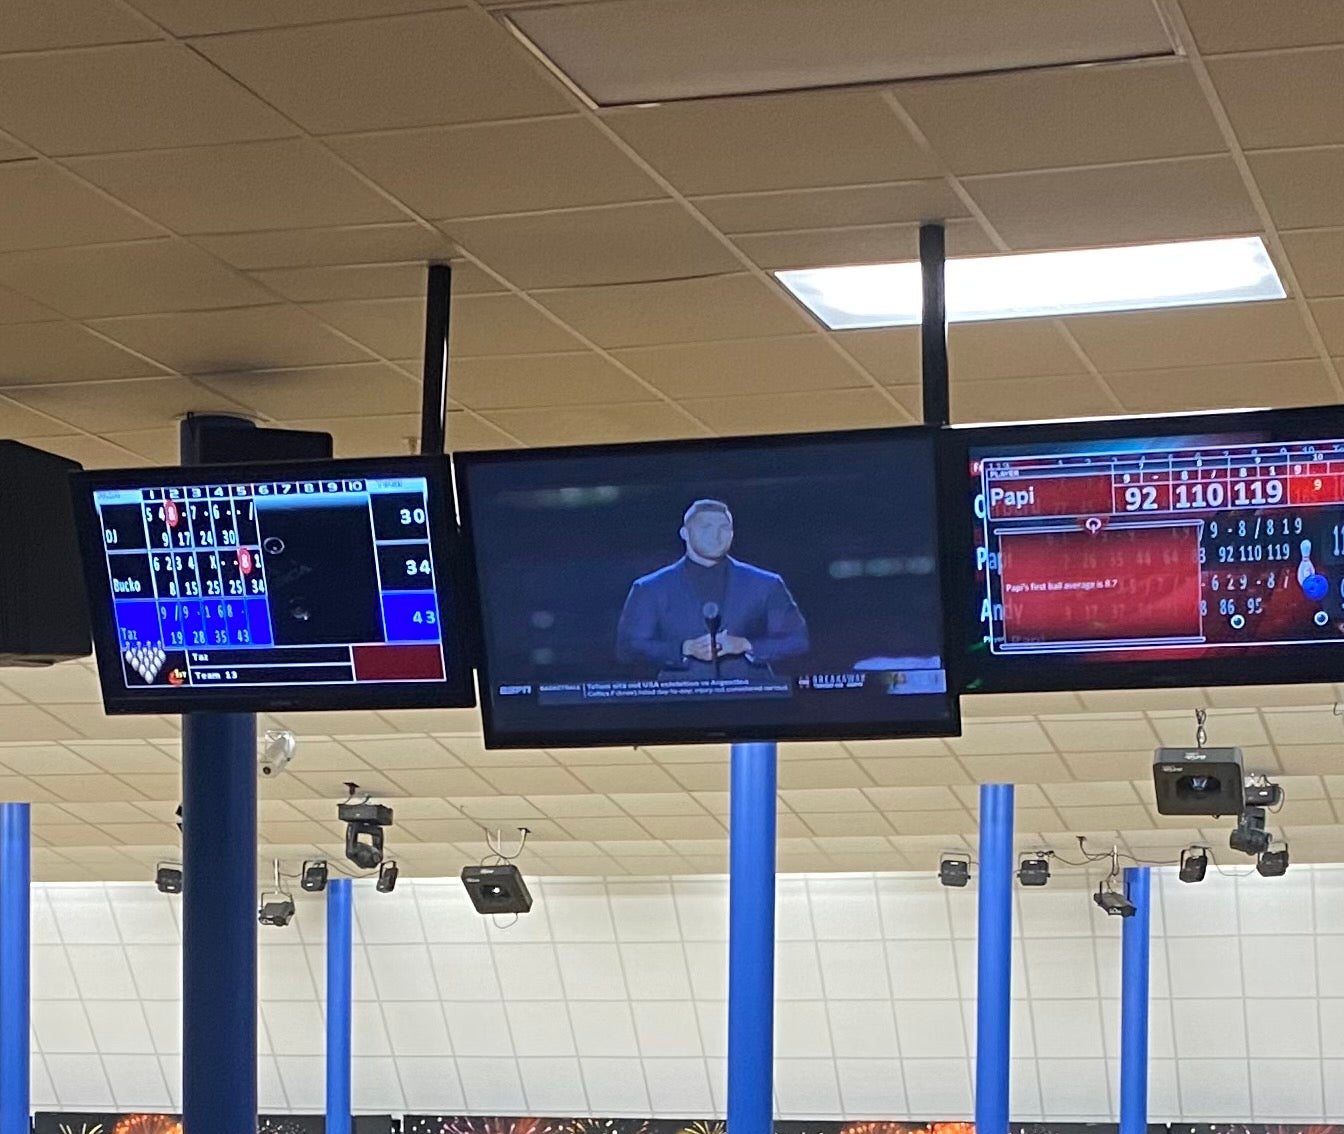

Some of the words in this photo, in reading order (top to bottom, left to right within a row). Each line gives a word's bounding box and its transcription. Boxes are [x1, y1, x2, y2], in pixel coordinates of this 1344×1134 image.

[990, 486, 1035, 509] Papi
[1124, 487, 1158, 512] 92
[1175, 483, 1224, 509] 110
[1234, 480, 1283, 505] 119
[1314, 479, 1323, 490] 9
[400, 508, 426, 524] 30
[162, 532, 169, 547] 9
[178, 531, 191, 546] 17
[200, 530, 214, 546] 24
[222, 530, 236, 545] 30
[1219, 546, 1234, 563] 92
[1240, 544, 1262, 562] 110
[1267, 543, 1290, 560] 119
[406, 559, 432, 576] 34
[113, 577, 142, 593] Bucko
[185, 580, 198, 596] 15
[207, 580, 221, 595] 25
[229, 580, 244, 594] 25
[251, 578, 265, 594] 34
[1220, 599, 1236, 615] 86
[413, 610, 436, 624] 43
[120, 627, 138, 640] Taz
[170, 630, 184, 645] 19
[193, 630, 206, 644] 28
[214, 630, 228, 644] 35
[237, 629, 250, 643] 43
[192, 653, 209, 662] Taz
[194, 671, 222, 680] Team
[225, 670, 238, 680] 13
